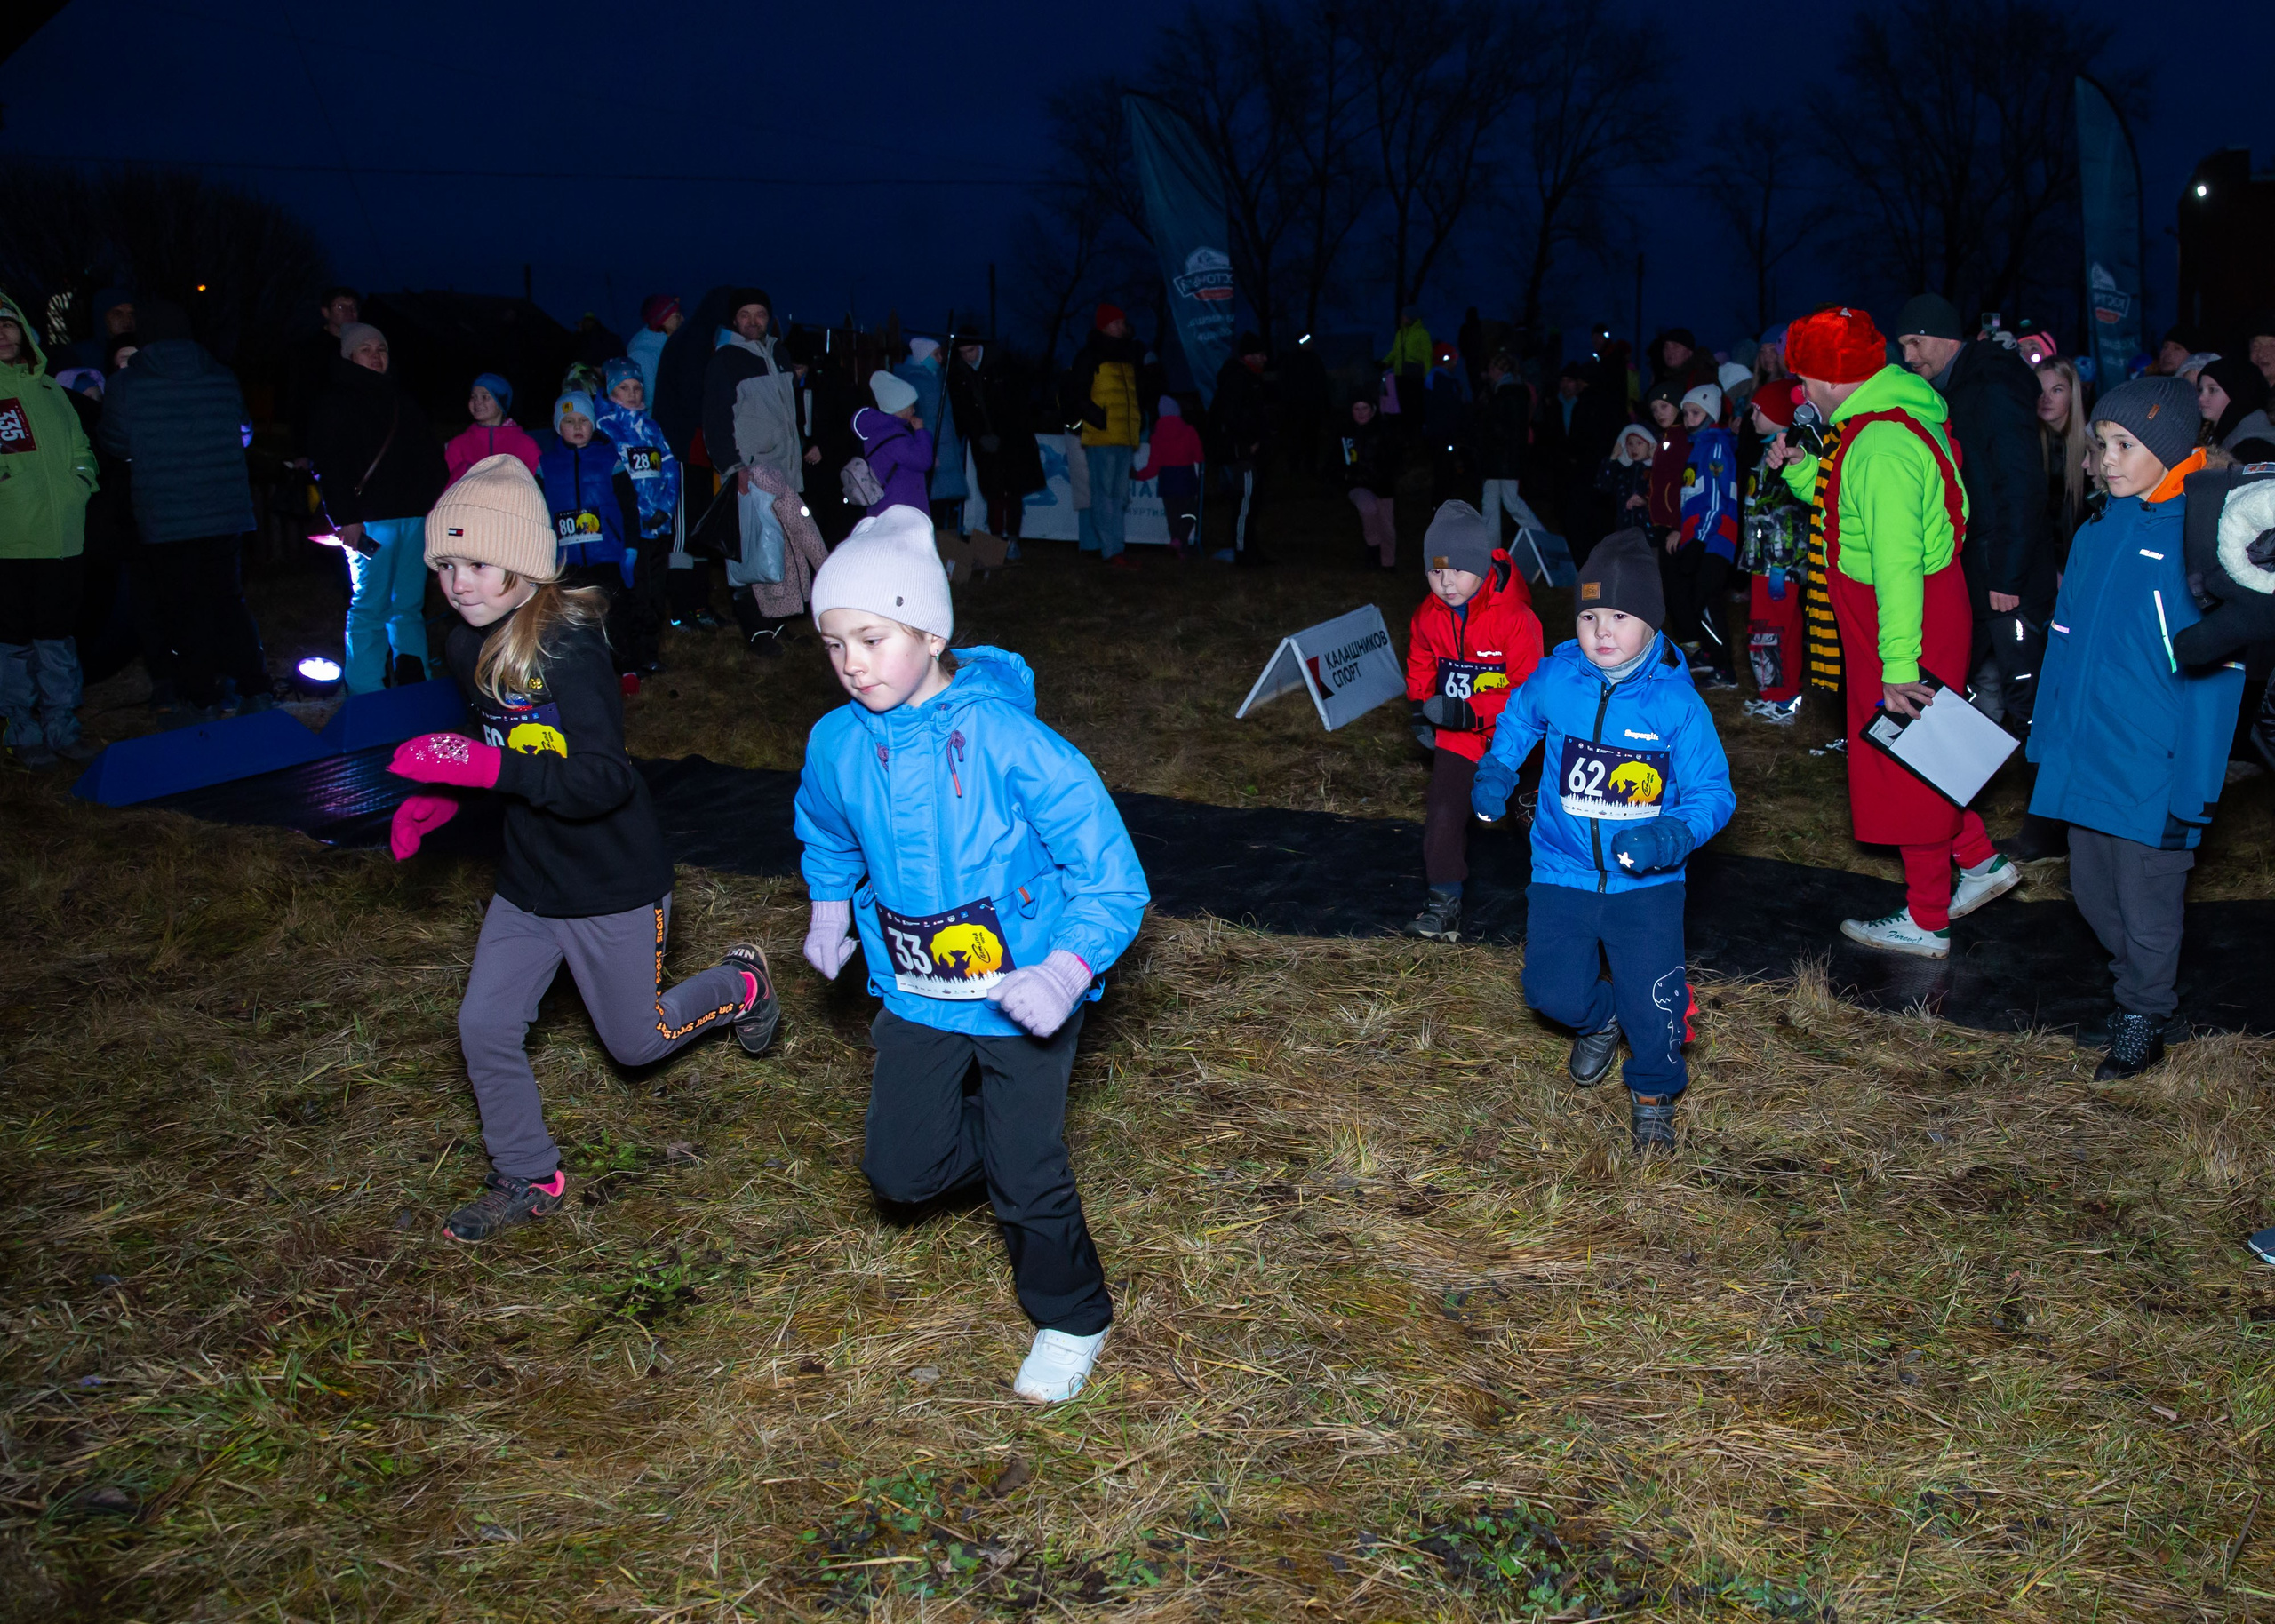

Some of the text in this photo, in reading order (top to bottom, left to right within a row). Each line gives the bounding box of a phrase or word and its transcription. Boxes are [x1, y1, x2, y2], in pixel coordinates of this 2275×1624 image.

[632, 452, 651, 470] 28
[558, 517, 576, 536] 80
[1324, 630, 1388, 670] КАЛАШНИКОВ
[1332, 662, 1361, 688] СПОРТ
[1444, 671, 1472, 700] 63
[1568, 756, 1606, 797] 62
[887, 926, 933, 975] 33
